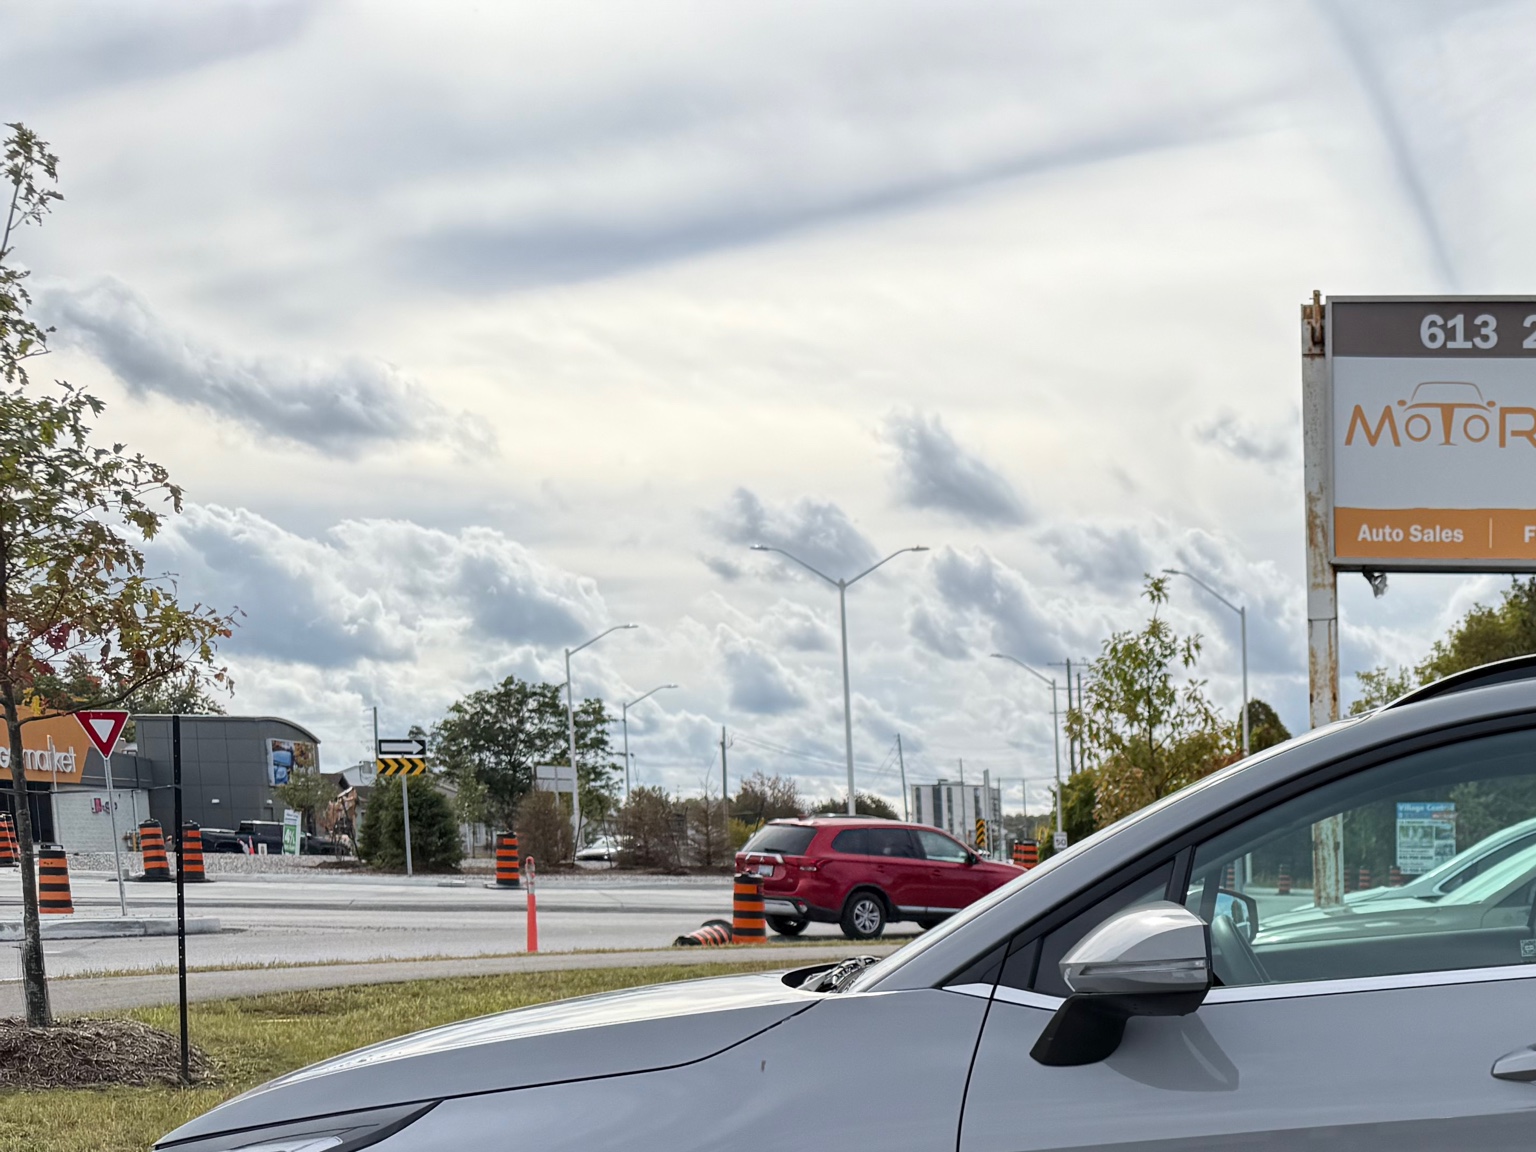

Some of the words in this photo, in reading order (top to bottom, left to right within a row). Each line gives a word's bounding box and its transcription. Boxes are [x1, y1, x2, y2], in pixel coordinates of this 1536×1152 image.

[1419, 313, 1498, 350] 613
[1357, 523, 1404, 543] Auto
[1408, 524, 1464, 543] Sales
